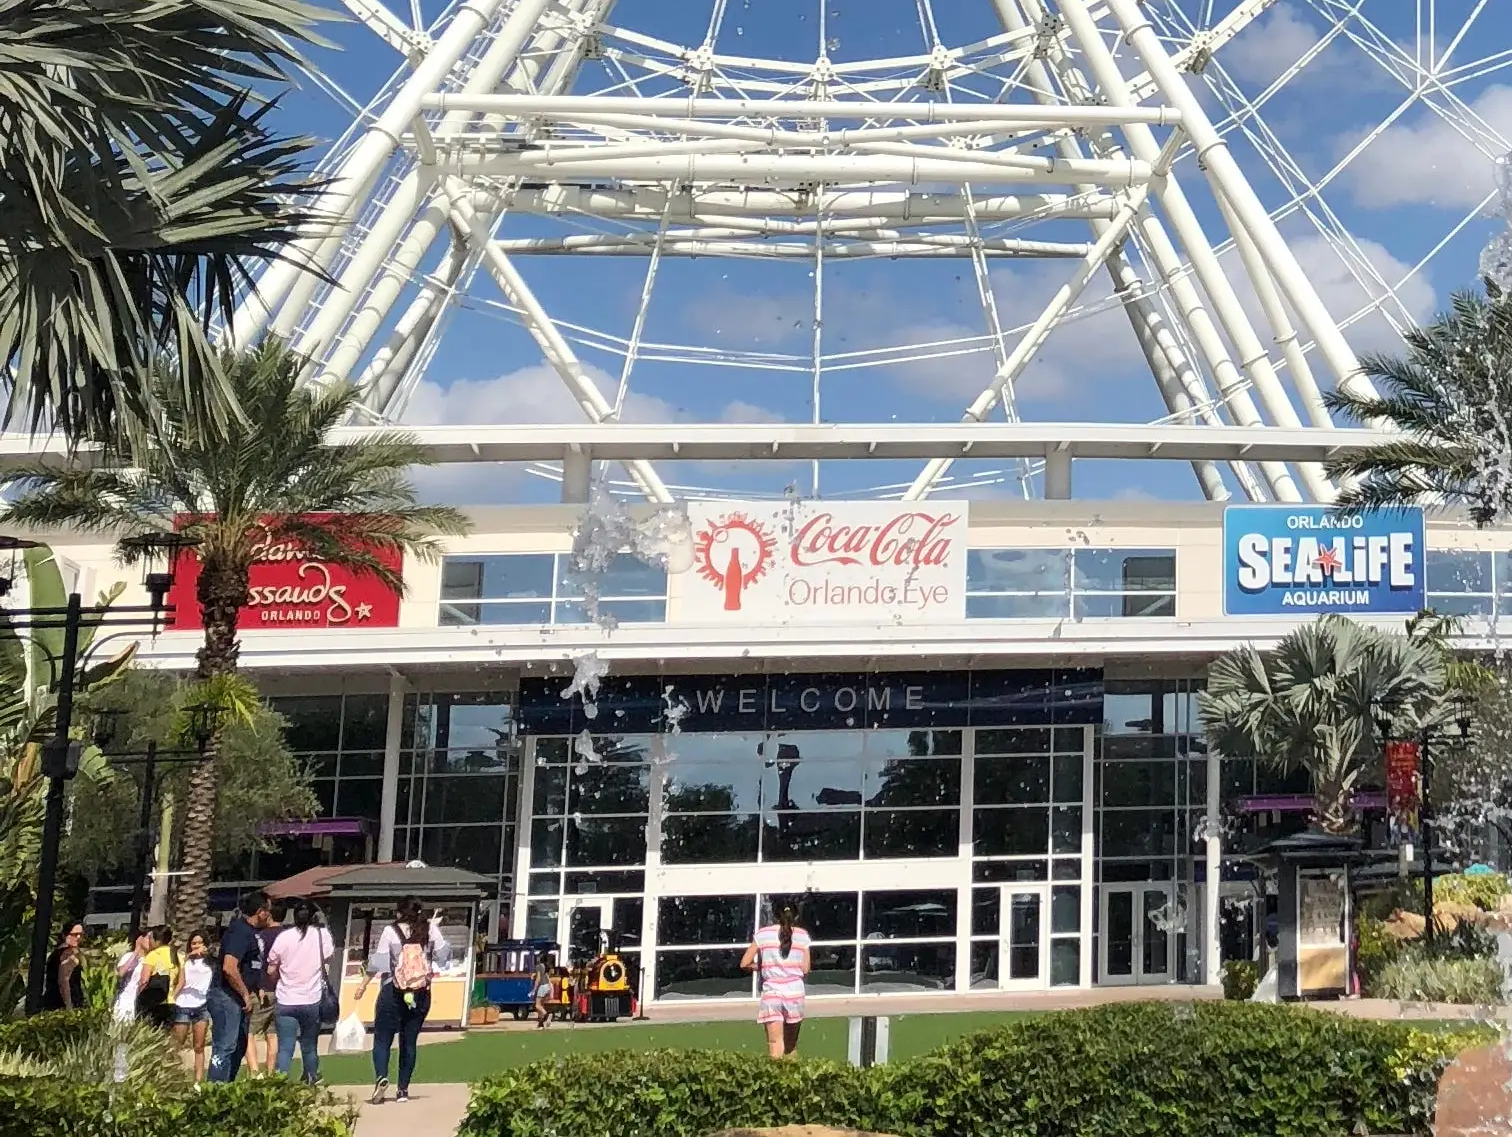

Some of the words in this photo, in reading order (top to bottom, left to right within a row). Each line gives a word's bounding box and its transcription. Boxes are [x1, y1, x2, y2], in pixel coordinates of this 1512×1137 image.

[1286, 515, 1364, 530] ORLANDO
[790, 512, 962, 567] Coca-Cola
[247, 562, 352, 623] ssauds
[788, 578, 898, 606] Orlando
[903, 576, 949, 611] Eye
[1282, 590, 1370, 606] AQUARIUM
[261, 610, 321, 621] ORLANDO
[696, 685, 924, 714] WELCOME
